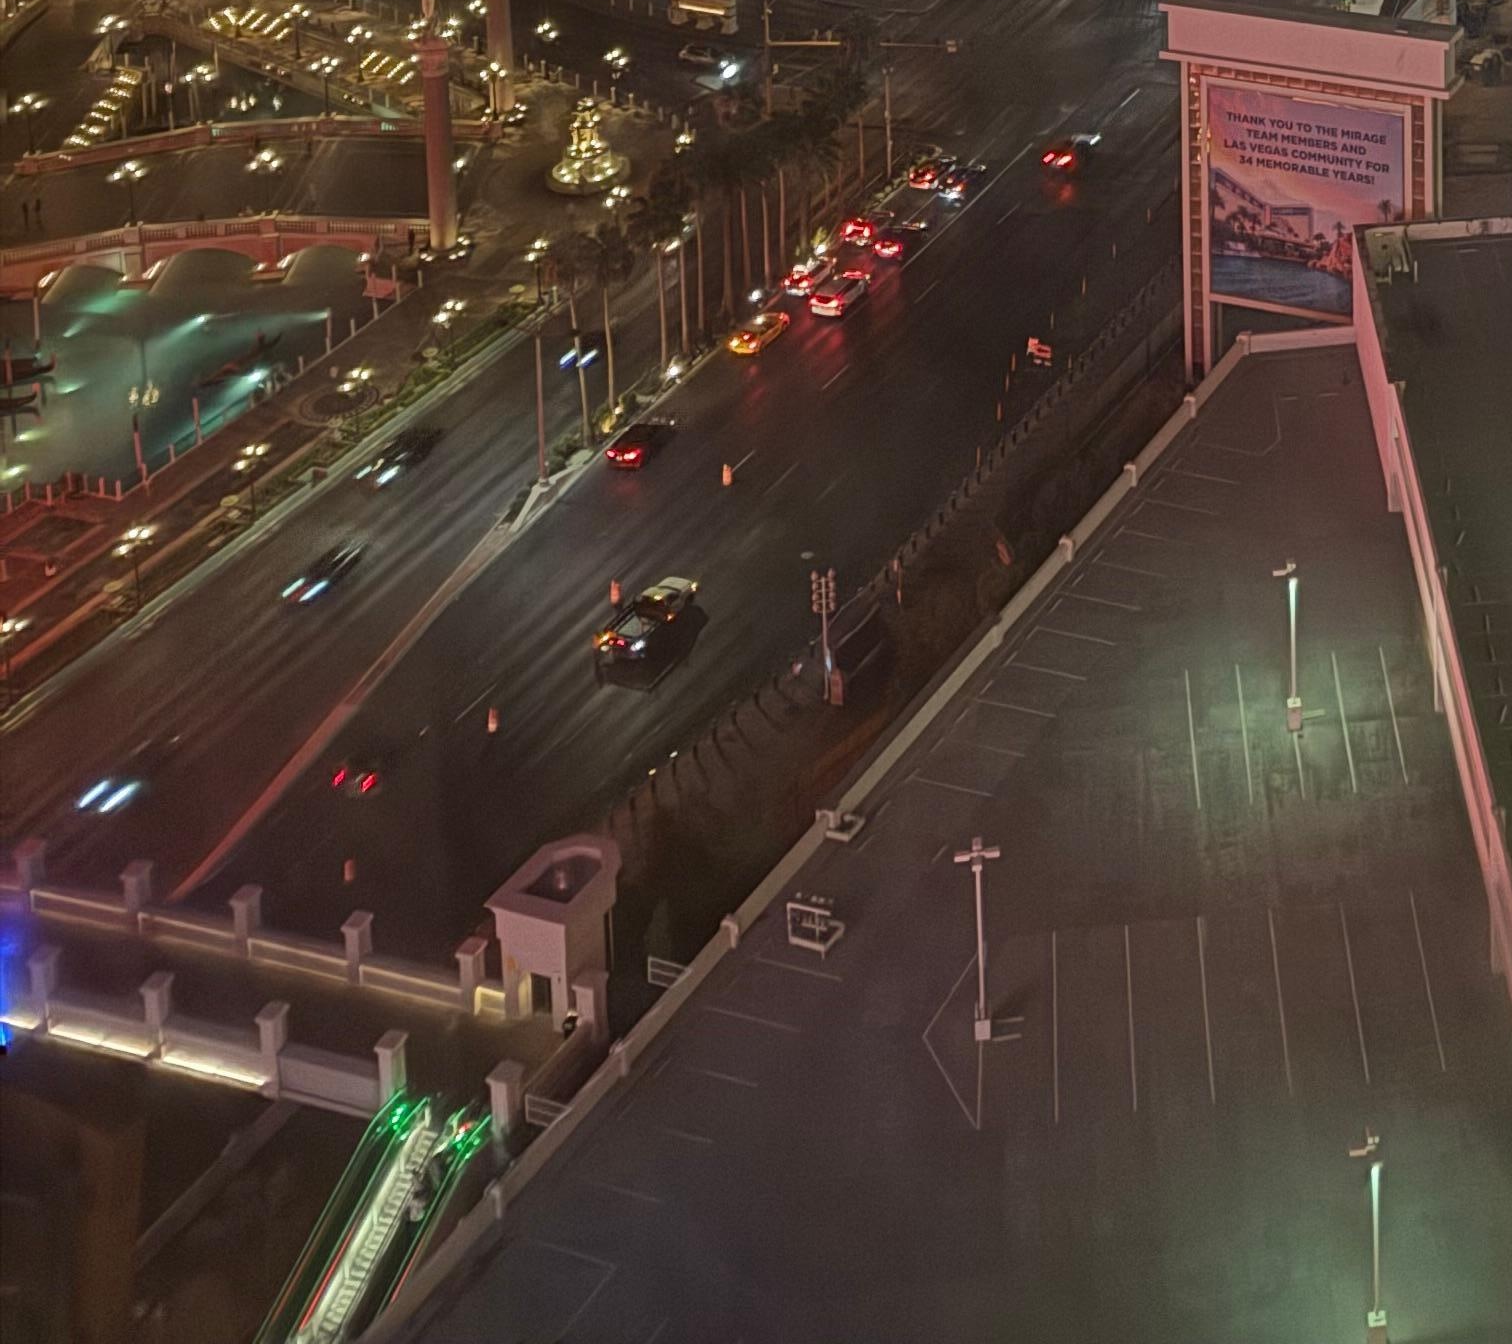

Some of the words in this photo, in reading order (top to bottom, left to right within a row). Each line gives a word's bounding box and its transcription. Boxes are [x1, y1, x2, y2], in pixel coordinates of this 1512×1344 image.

[1226, 111, 1266, 127] THANK
[1270, 118, 1294, 131] YOU
[1296, 122, 1313, 133] TO
[1315, 124, 1338, 137] THE
[1341, 129, 1388, 145] MIRAGE
[1246, 128, 1279, 142] TEAM
[1281, 133, 1338, 151] MEMBERS
[1340, 142, 1367, 156] AND
[1223, 138, 1247, 151] LAS
[1249, 143, 1289, 158] VEGAS
[1290, 149, 1363, 170] COMMUNITY
[1365, 161, 1390, 174] FOR
[1238, 154, 1253, 166] 34
[1255, 157, 1330, 178] MEMORABLE
[1332, 169, 1376, 186] YEARS!
